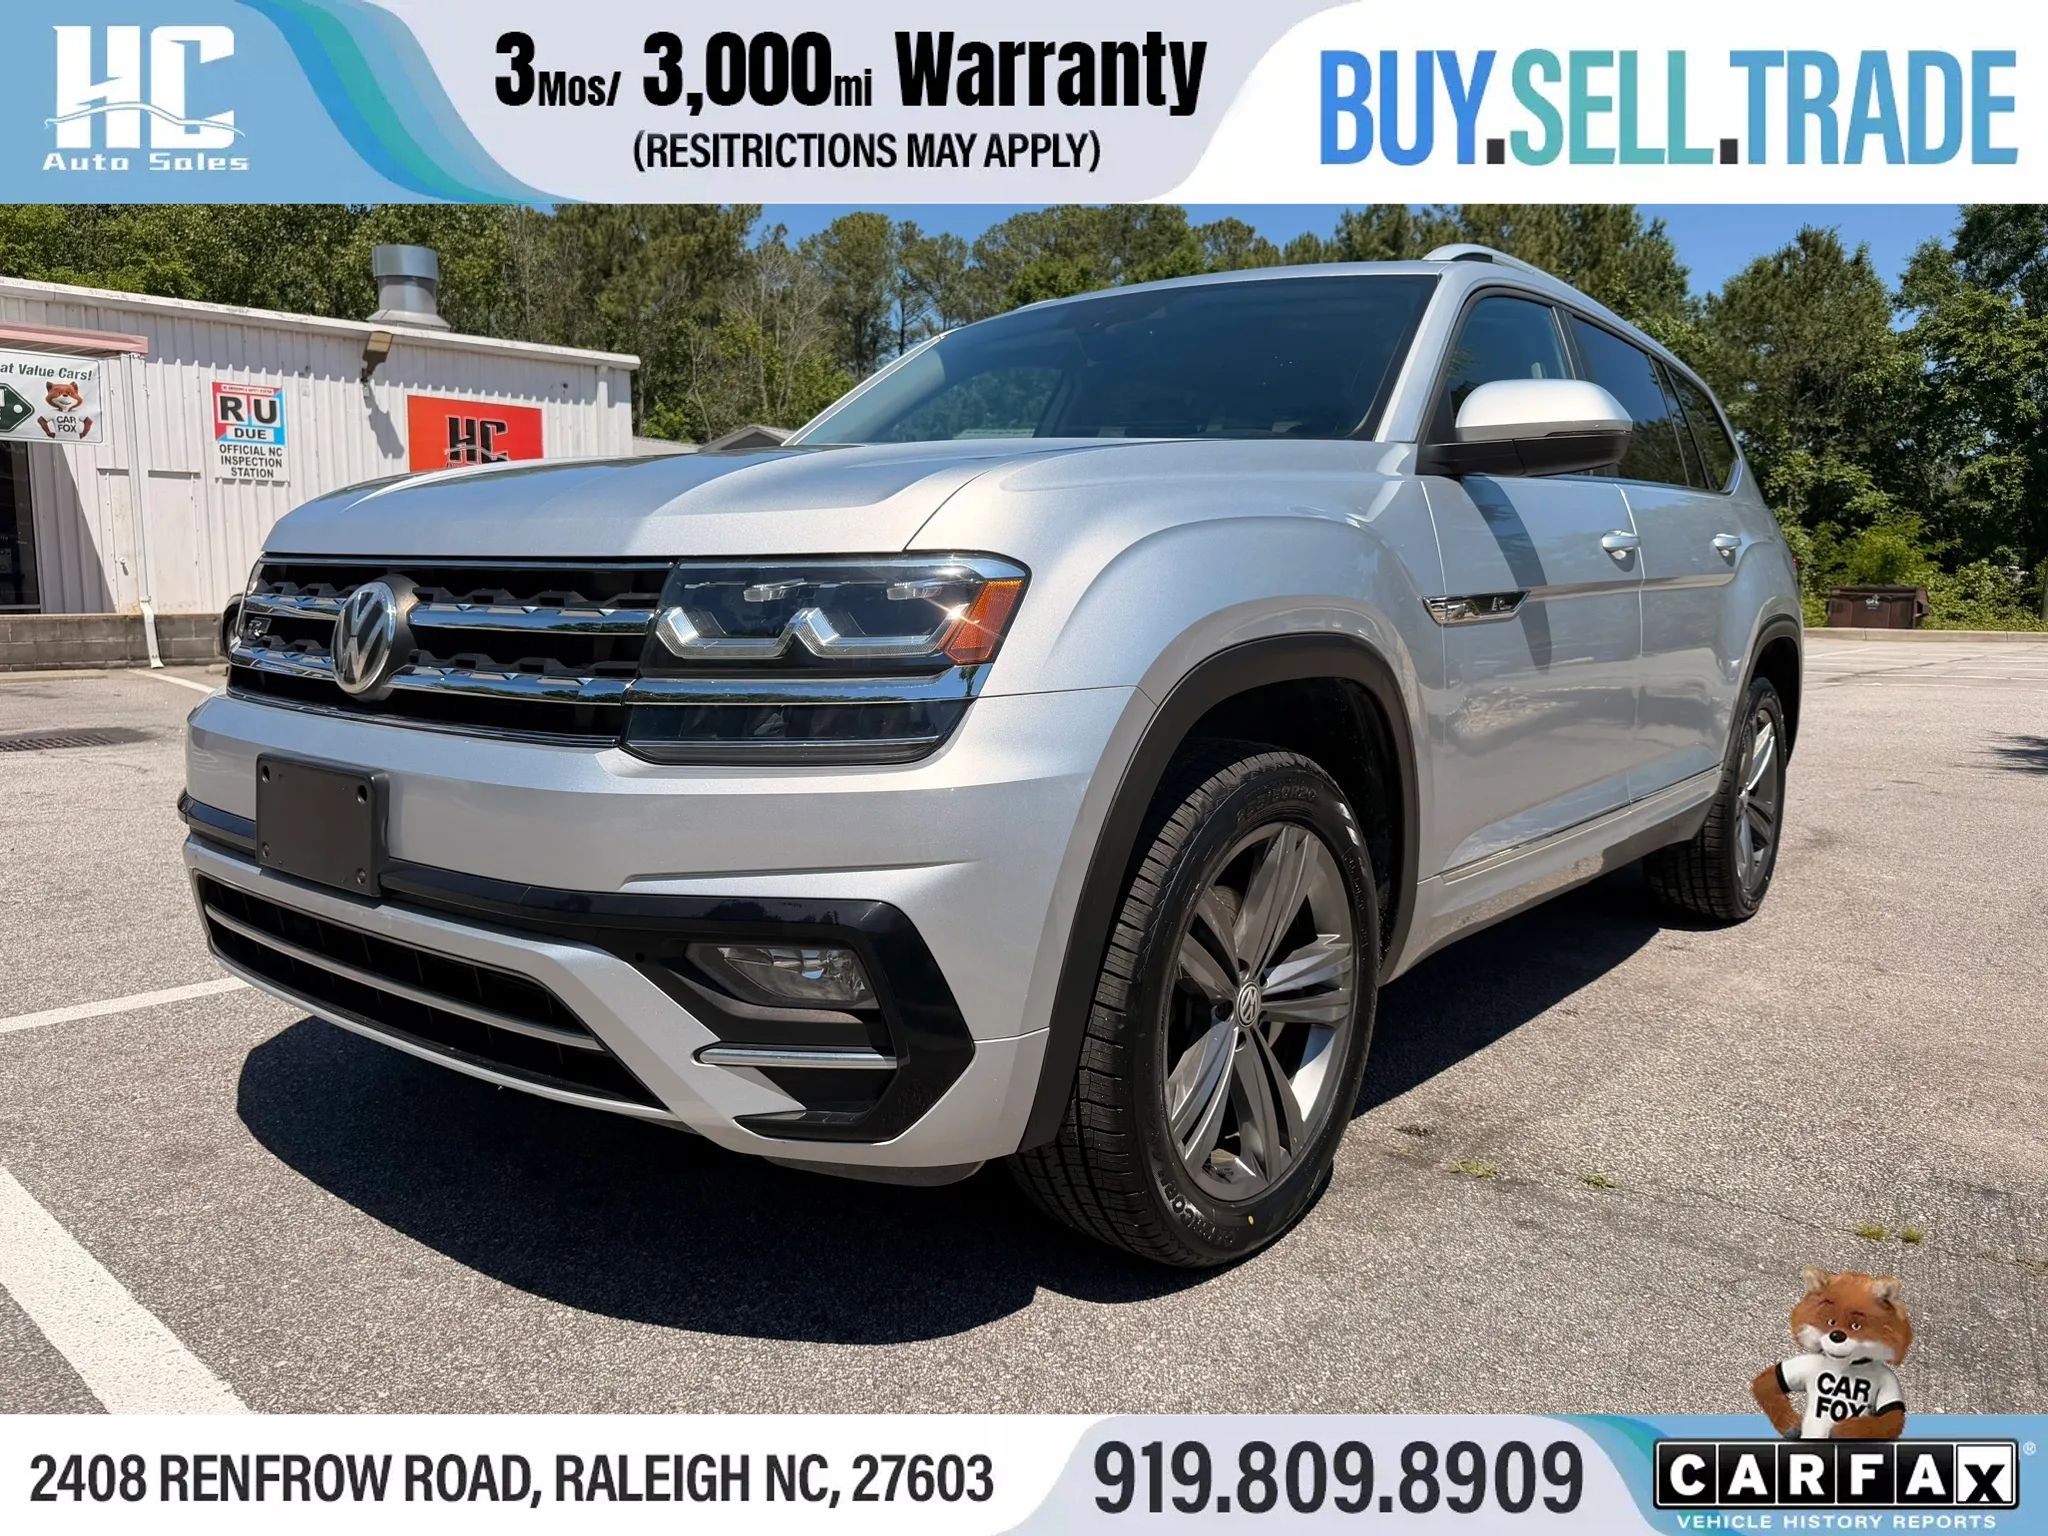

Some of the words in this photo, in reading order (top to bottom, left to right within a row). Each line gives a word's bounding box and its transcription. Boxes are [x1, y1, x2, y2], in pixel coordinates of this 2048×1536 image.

[19, 363, 55, 377] Value
[58, 367, 93, 381] Cars!
[56, 415, 77, 424] CAR
[57, 424, 77, 433] FOX
[234, 427, 267, 440] DUE
[219, 444, 266, 456] OFFICIAL
[268, 447, 283, 457] NC
[220, 455, 282, 468] INSPECTION
[231, 467, 274, 478] STATION
